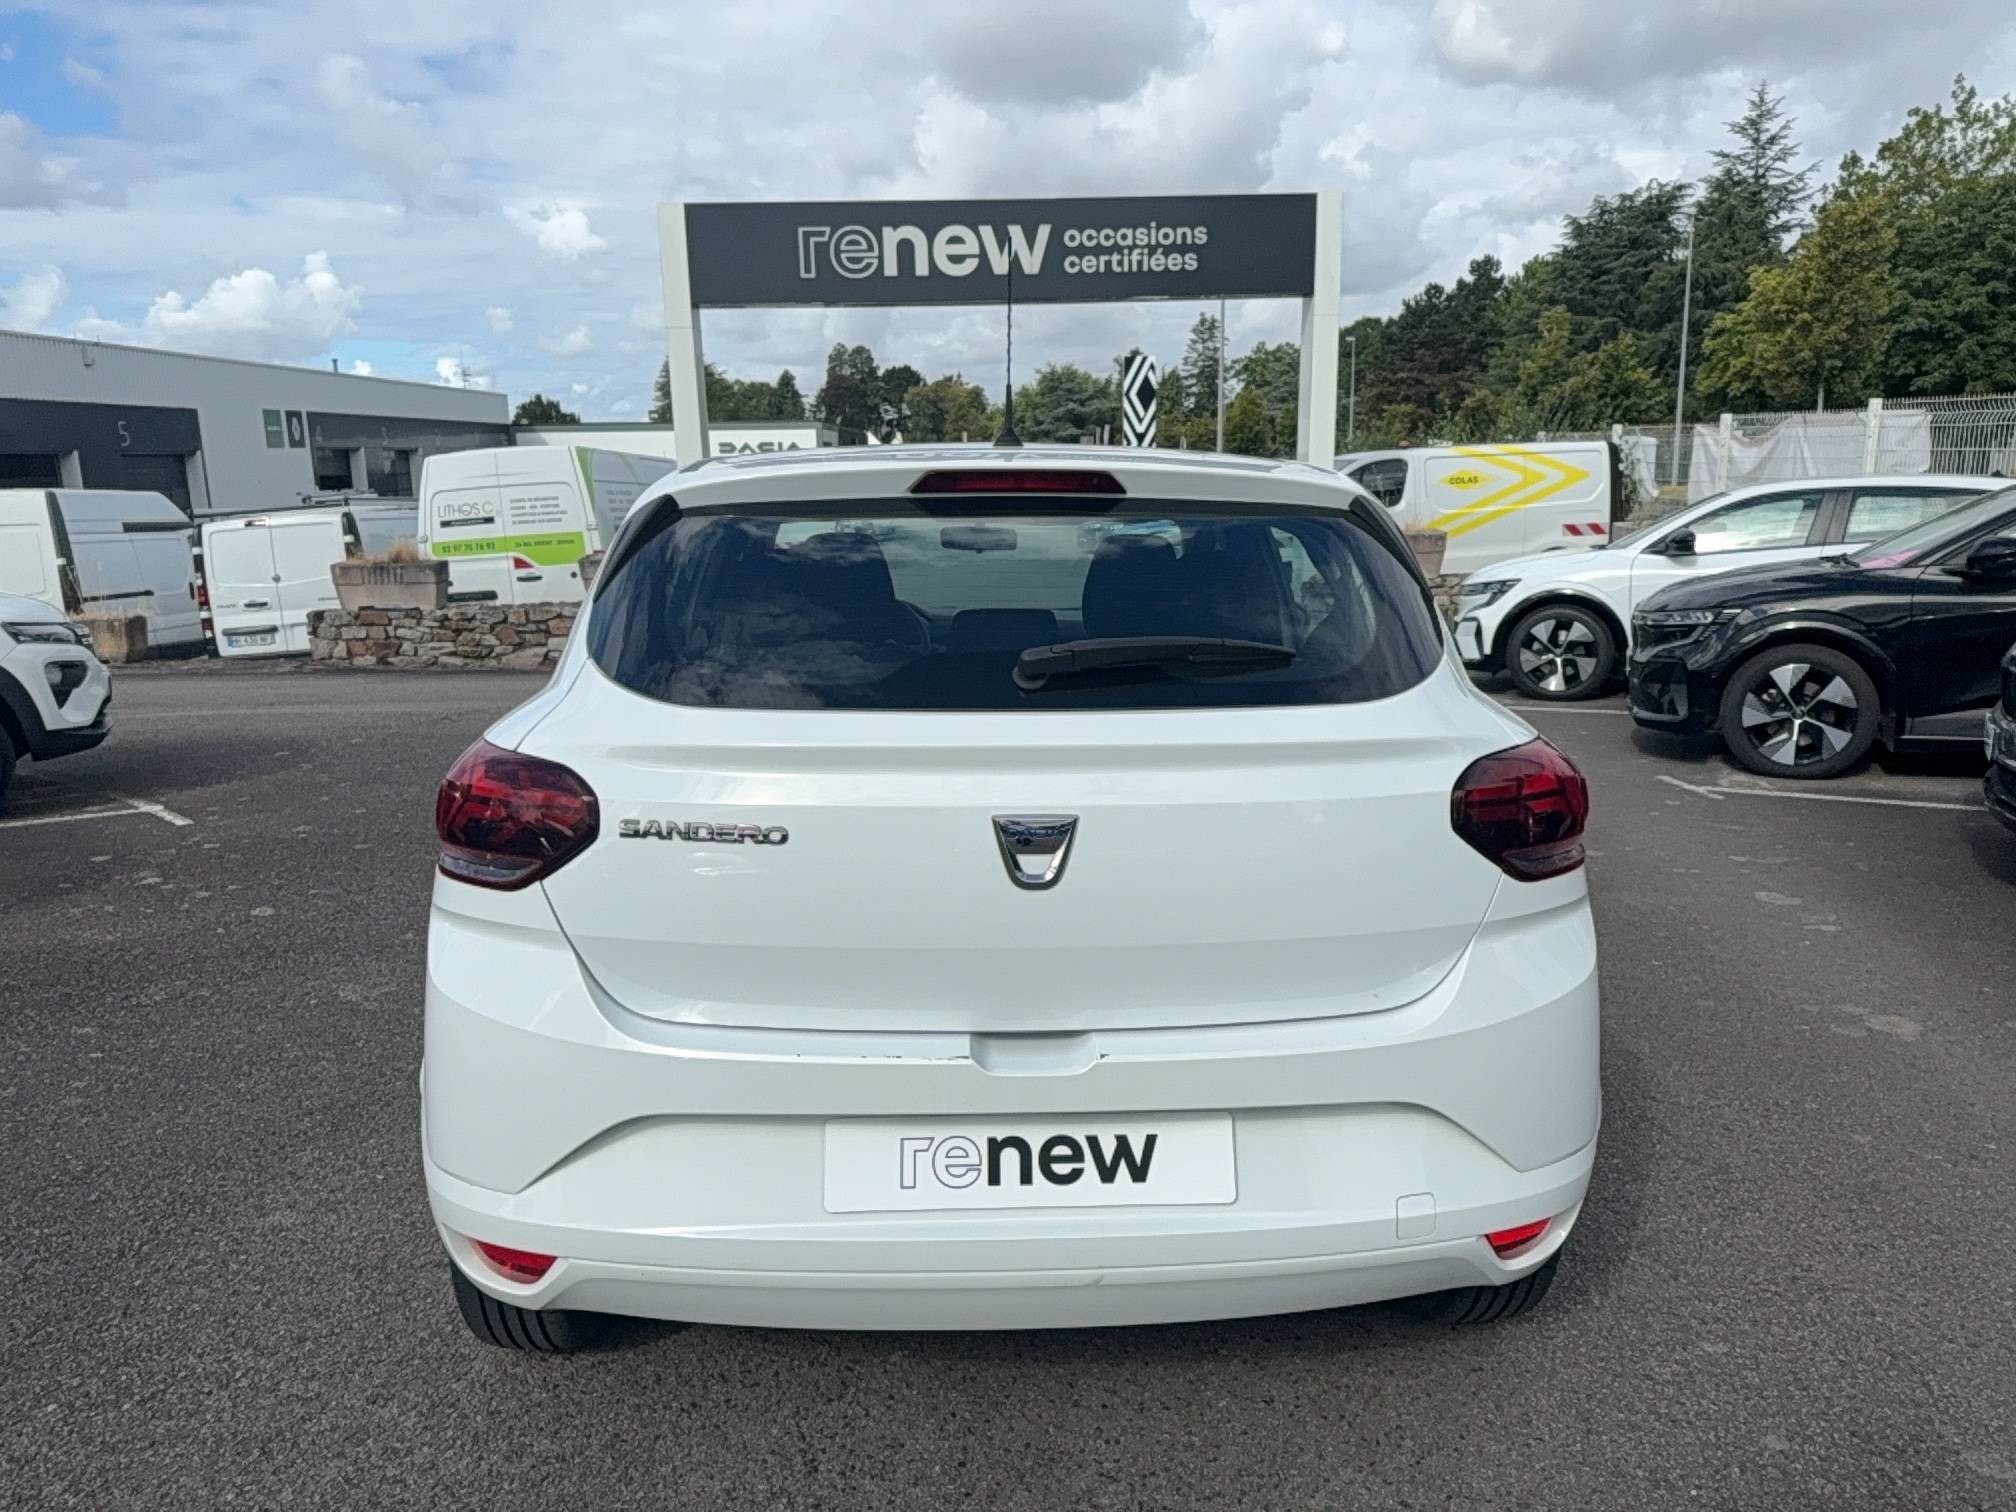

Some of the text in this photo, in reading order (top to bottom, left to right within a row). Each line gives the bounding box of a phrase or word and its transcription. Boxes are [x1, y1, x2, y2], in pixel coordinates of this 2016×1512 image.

[1063, 221, 1208, 248] occasions
[797, 223, 1052, 279] renew
[1063, 248, 1199, 274] certifiées
[117, 420, 131, 447] 5
[718, 441, 802, 455] DACIA
[1448, 476, 1479, 485] COLAS
[437, 502, 481, 518] LITHOS
[618, 818, 789, 846] SANDERO
[899, 1133, 1159, 1190] renew
